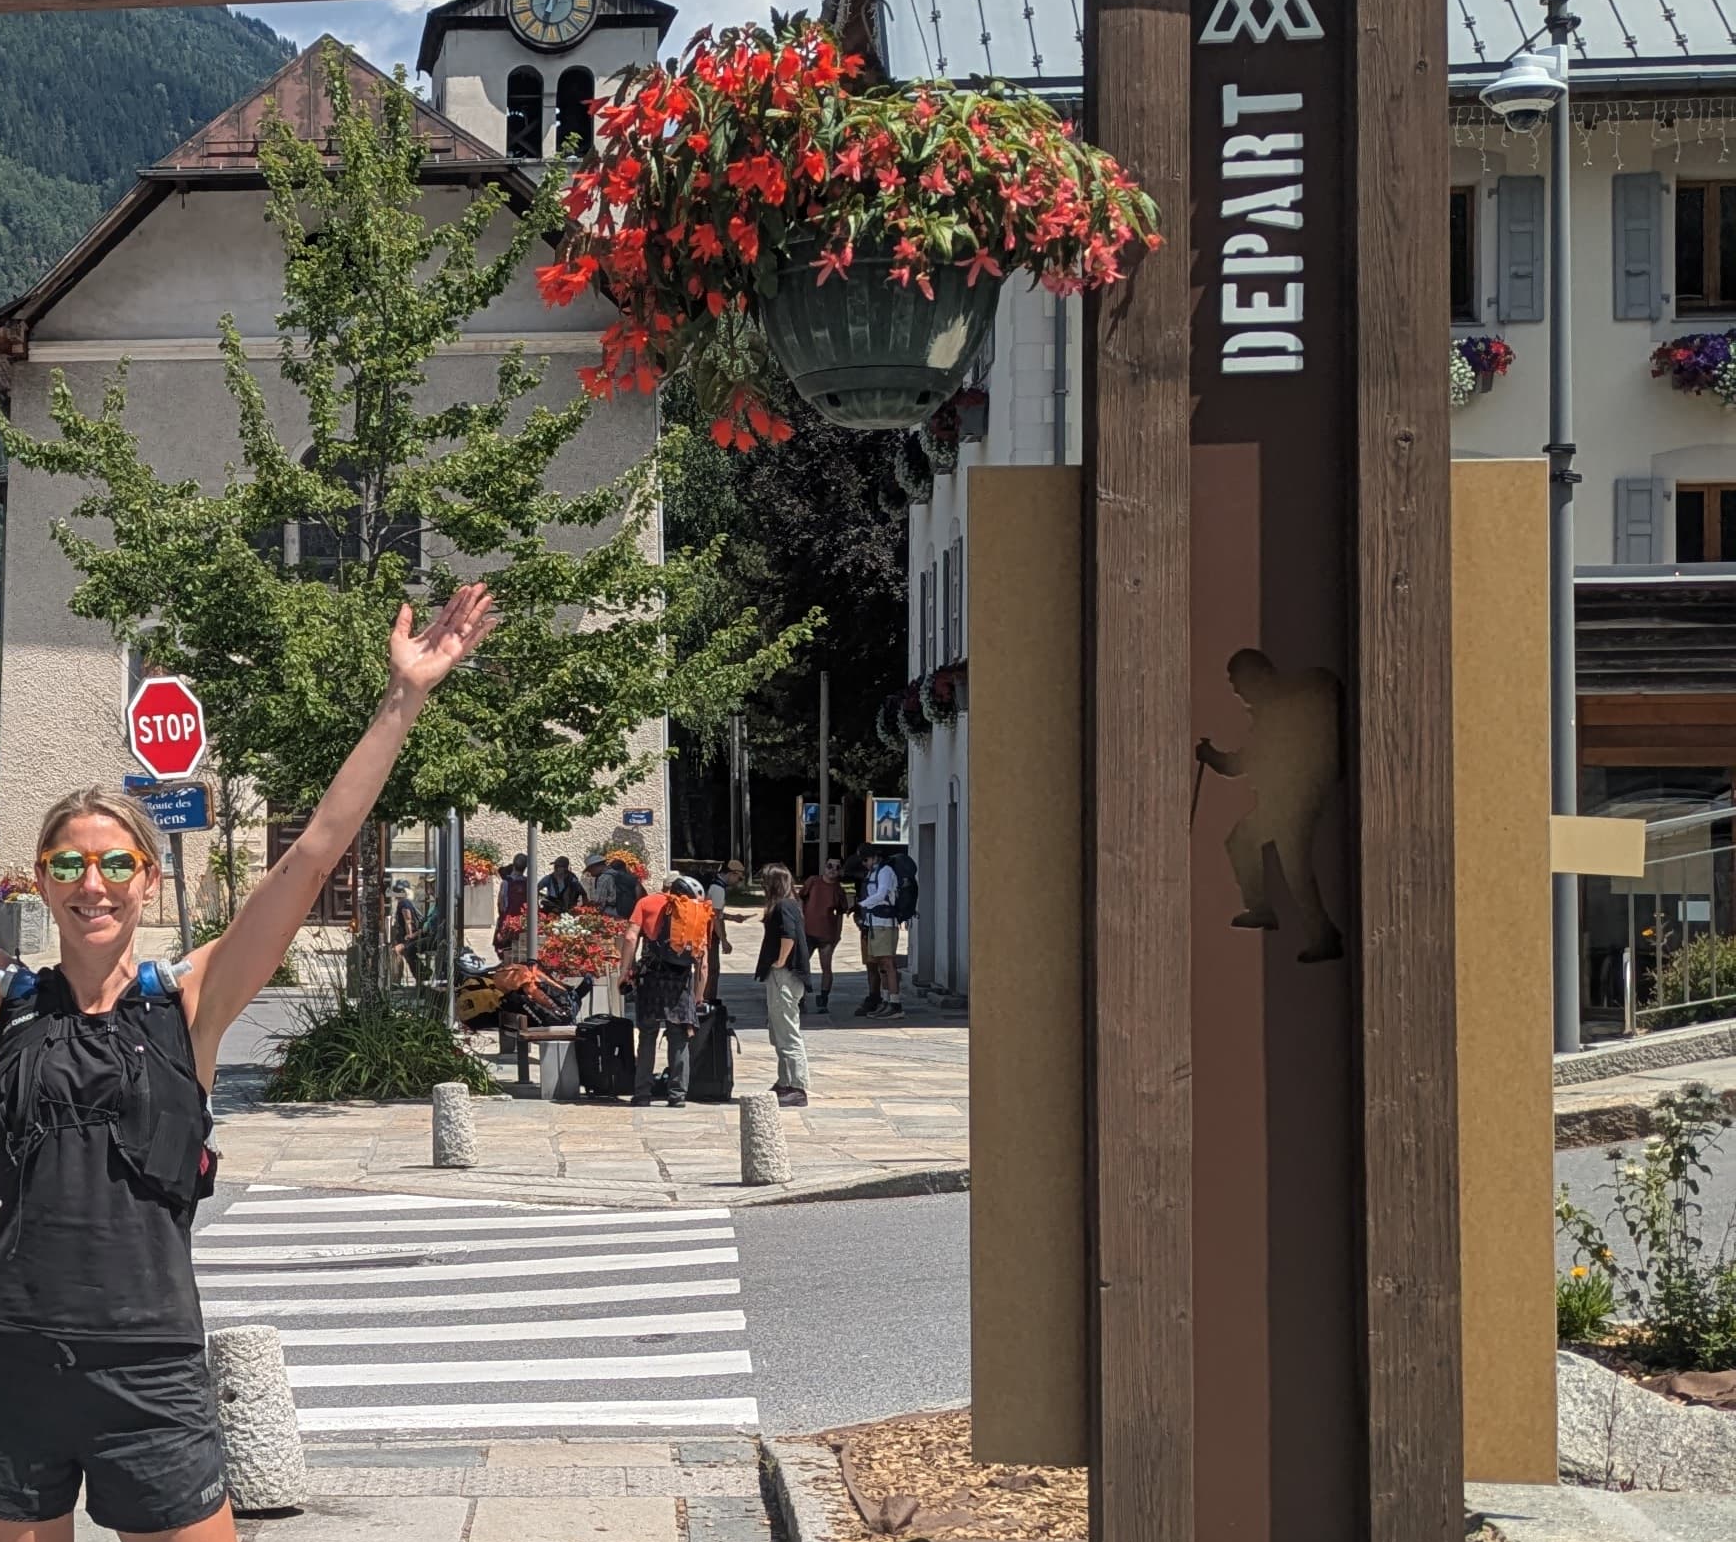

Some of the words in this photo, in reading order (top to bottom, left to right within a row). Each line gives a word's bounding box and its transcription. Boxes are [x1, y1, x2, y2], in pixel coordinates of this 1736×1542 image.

[1220, 82, 1305, 375] DEPART
[138, 713, 196, 744] STOP
[147, 801, 174, 811] Route
[175, 799, 192, 809] des
[153, 813, 187, 825] Gens
